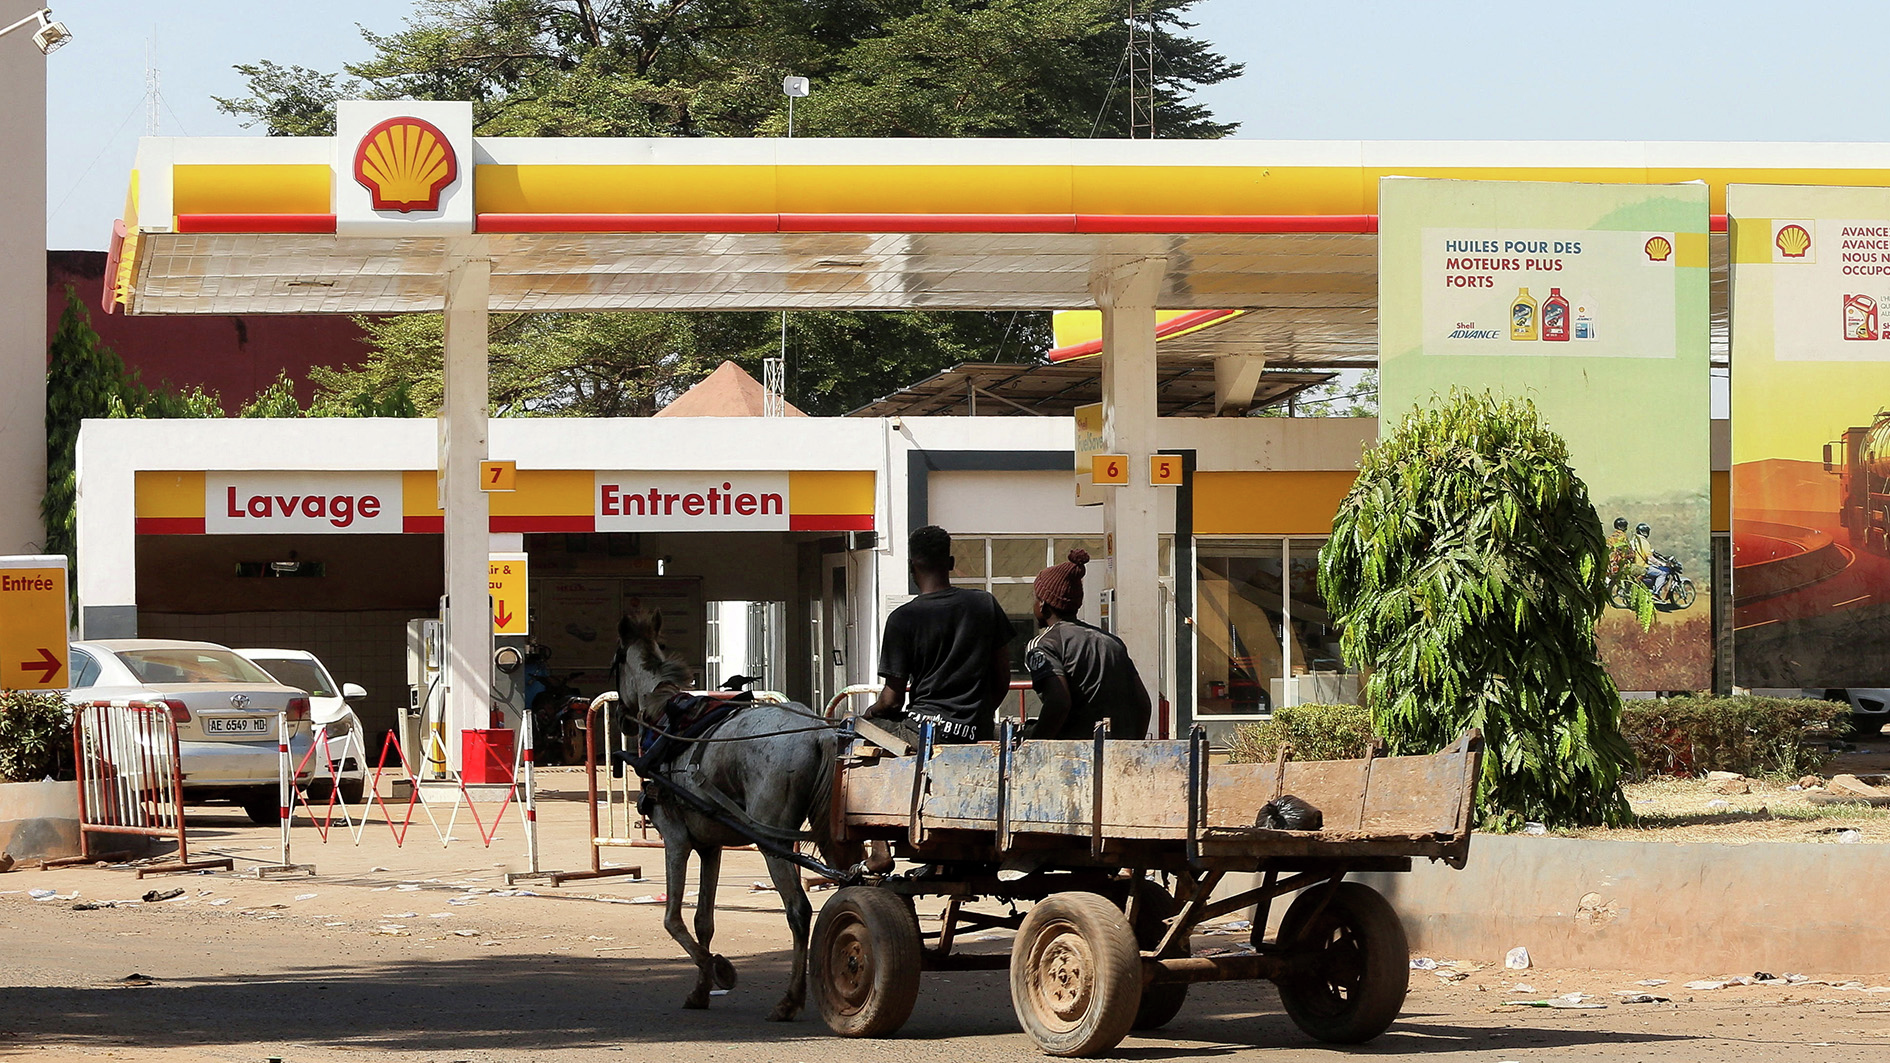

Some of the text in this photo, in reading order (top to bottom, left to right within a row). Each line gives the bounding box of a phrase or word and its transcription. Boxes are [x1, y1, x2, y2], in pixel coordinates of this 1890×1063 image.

[1446, 240, 1582, 254] HUILES POUR DES
[1842, 253, 1877, 262] NOUS
[1446, 258, 1563, 271] MOTEURS PLUS
[1842, 265, 1890, 275] OCCUPO
[1446, 275, 1494, 288] FORTS
[1447, 330, 1501, 340] ADVANCE
[490, 467, 503, 483] 7
[1107, 461, 1119, 478] 6
[1160, 463, 1170, 478] 5
[601, 481, 783, 516] Entretien
[227, 486, 381, 528] Lavage
[488, 565, 512, 575] ir &
[2, 574, 54, 591] Entrée
[488, 581, 503, 589] au
[210, 719, 265, 731] AE 6549 MD
